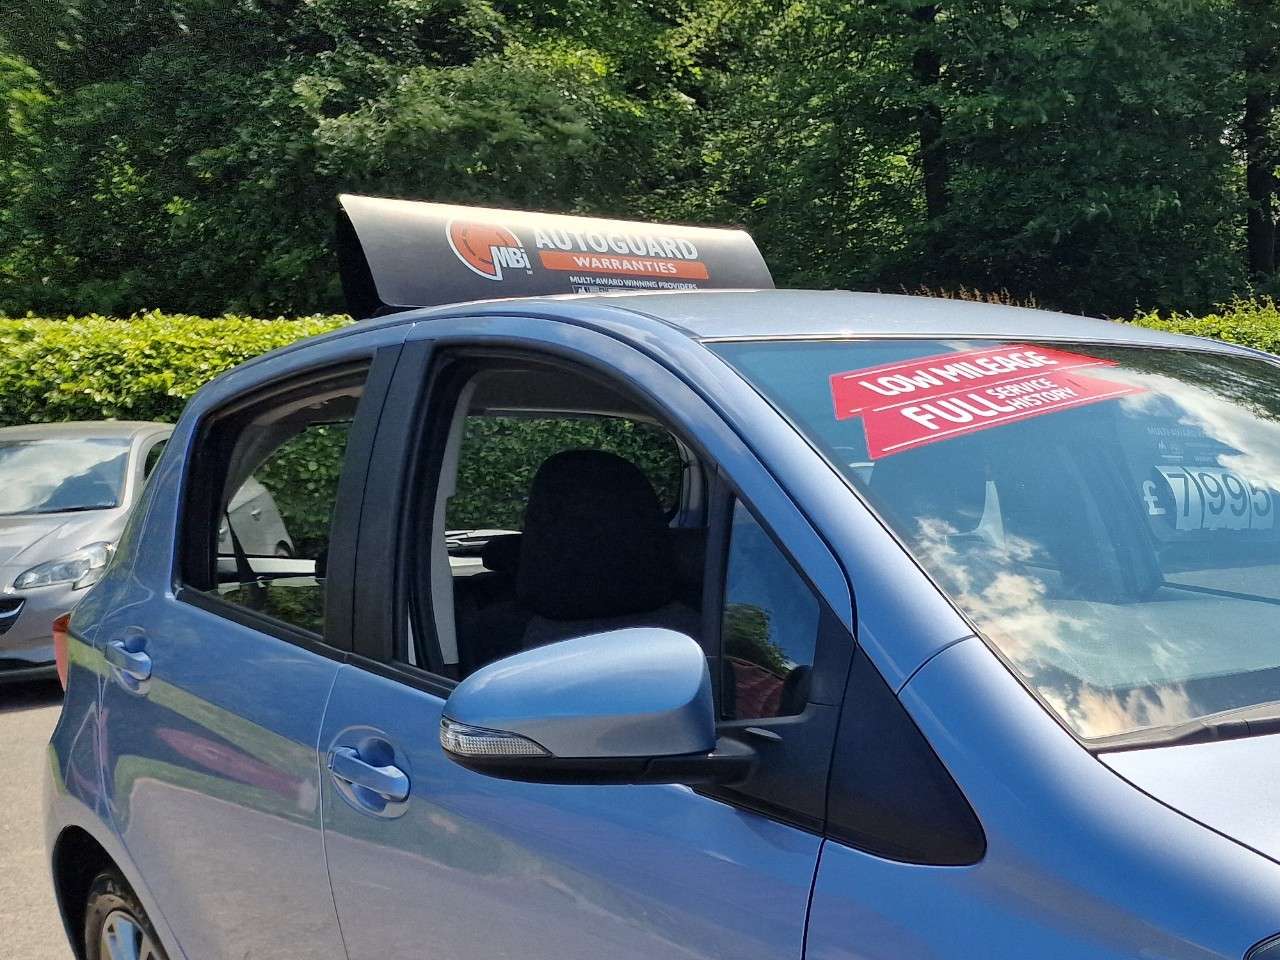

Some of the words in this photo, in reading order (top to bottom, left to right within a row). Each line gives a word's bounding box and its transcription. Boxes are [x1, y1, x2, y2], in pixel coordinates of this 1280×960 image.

[534, 226, 698, 261] AUTOGUARD
[573, 255, 678, 274] WARRANTIES
[624, 279, 658, 289] WINNING
[858, 375, 944, 397] LOW
[935, 350, 1058, 383] MILEAGE
[985, 377, 1058, 400] SERVICE
[1008, 386, 1079, 410] HISTORY
[900, 393, 1015, 430] FULL
